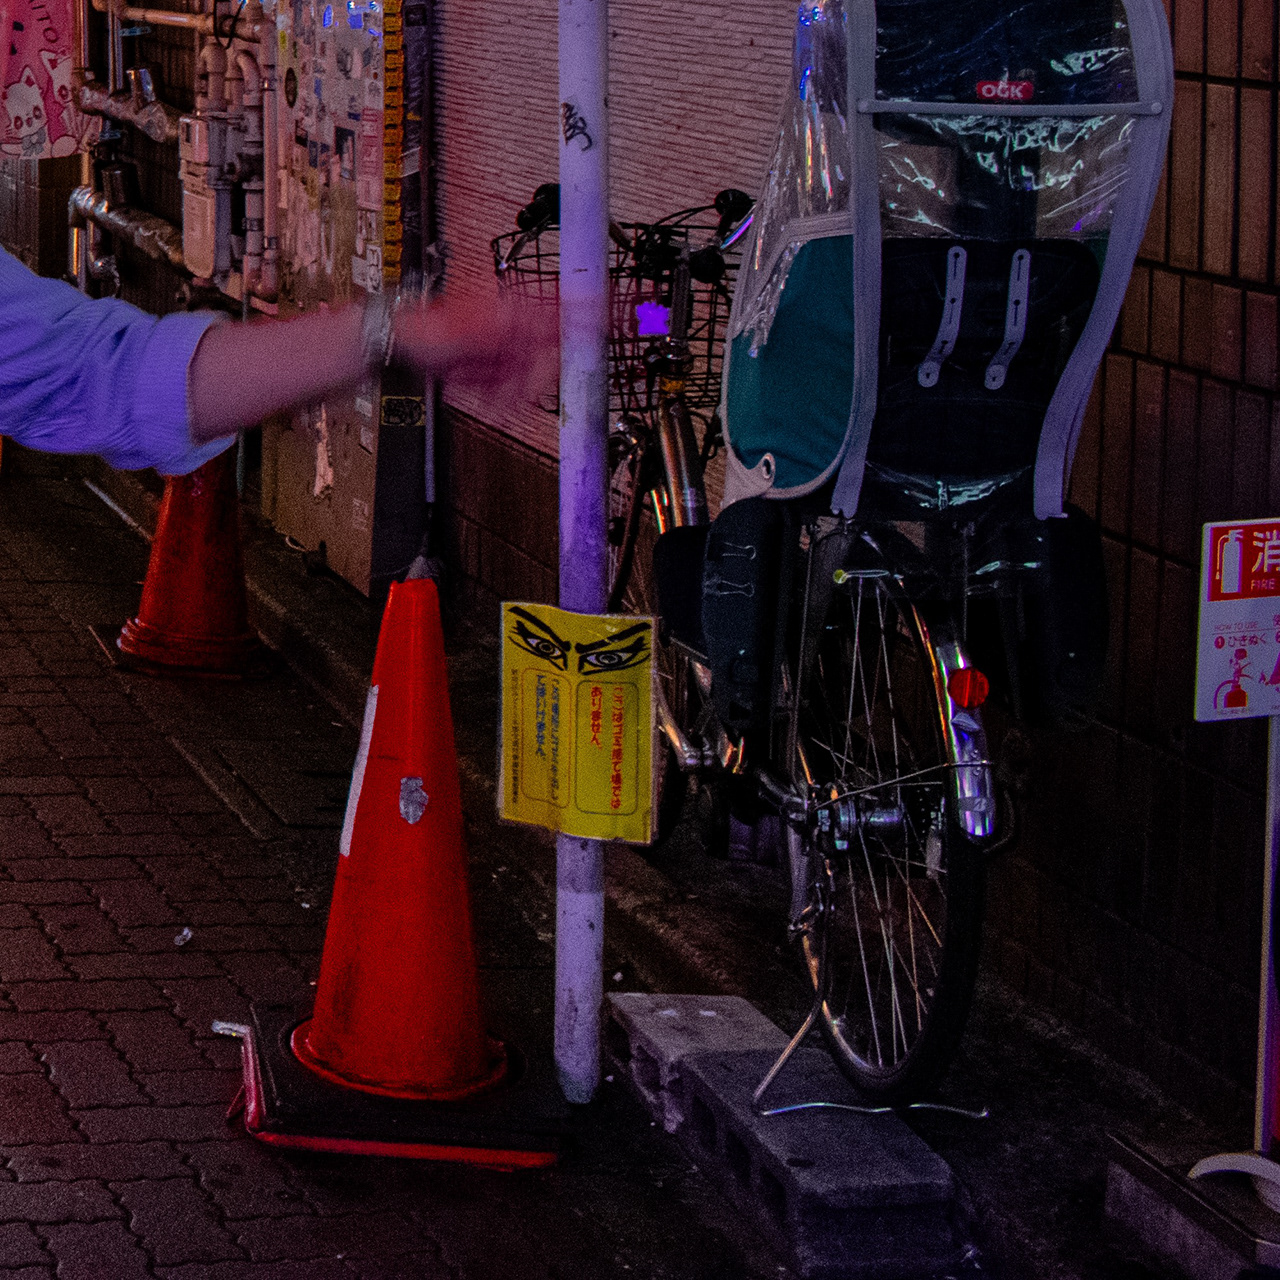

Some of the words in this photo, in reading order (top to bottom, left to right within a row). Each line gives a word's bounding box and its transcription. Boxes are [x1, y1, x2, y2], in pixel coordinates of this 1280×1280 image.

[981, 84, 1024, 99] OGK
[1250, 579, 1276, 591] FIRE
[1227, 632, 1268, 648] ひきぬく
